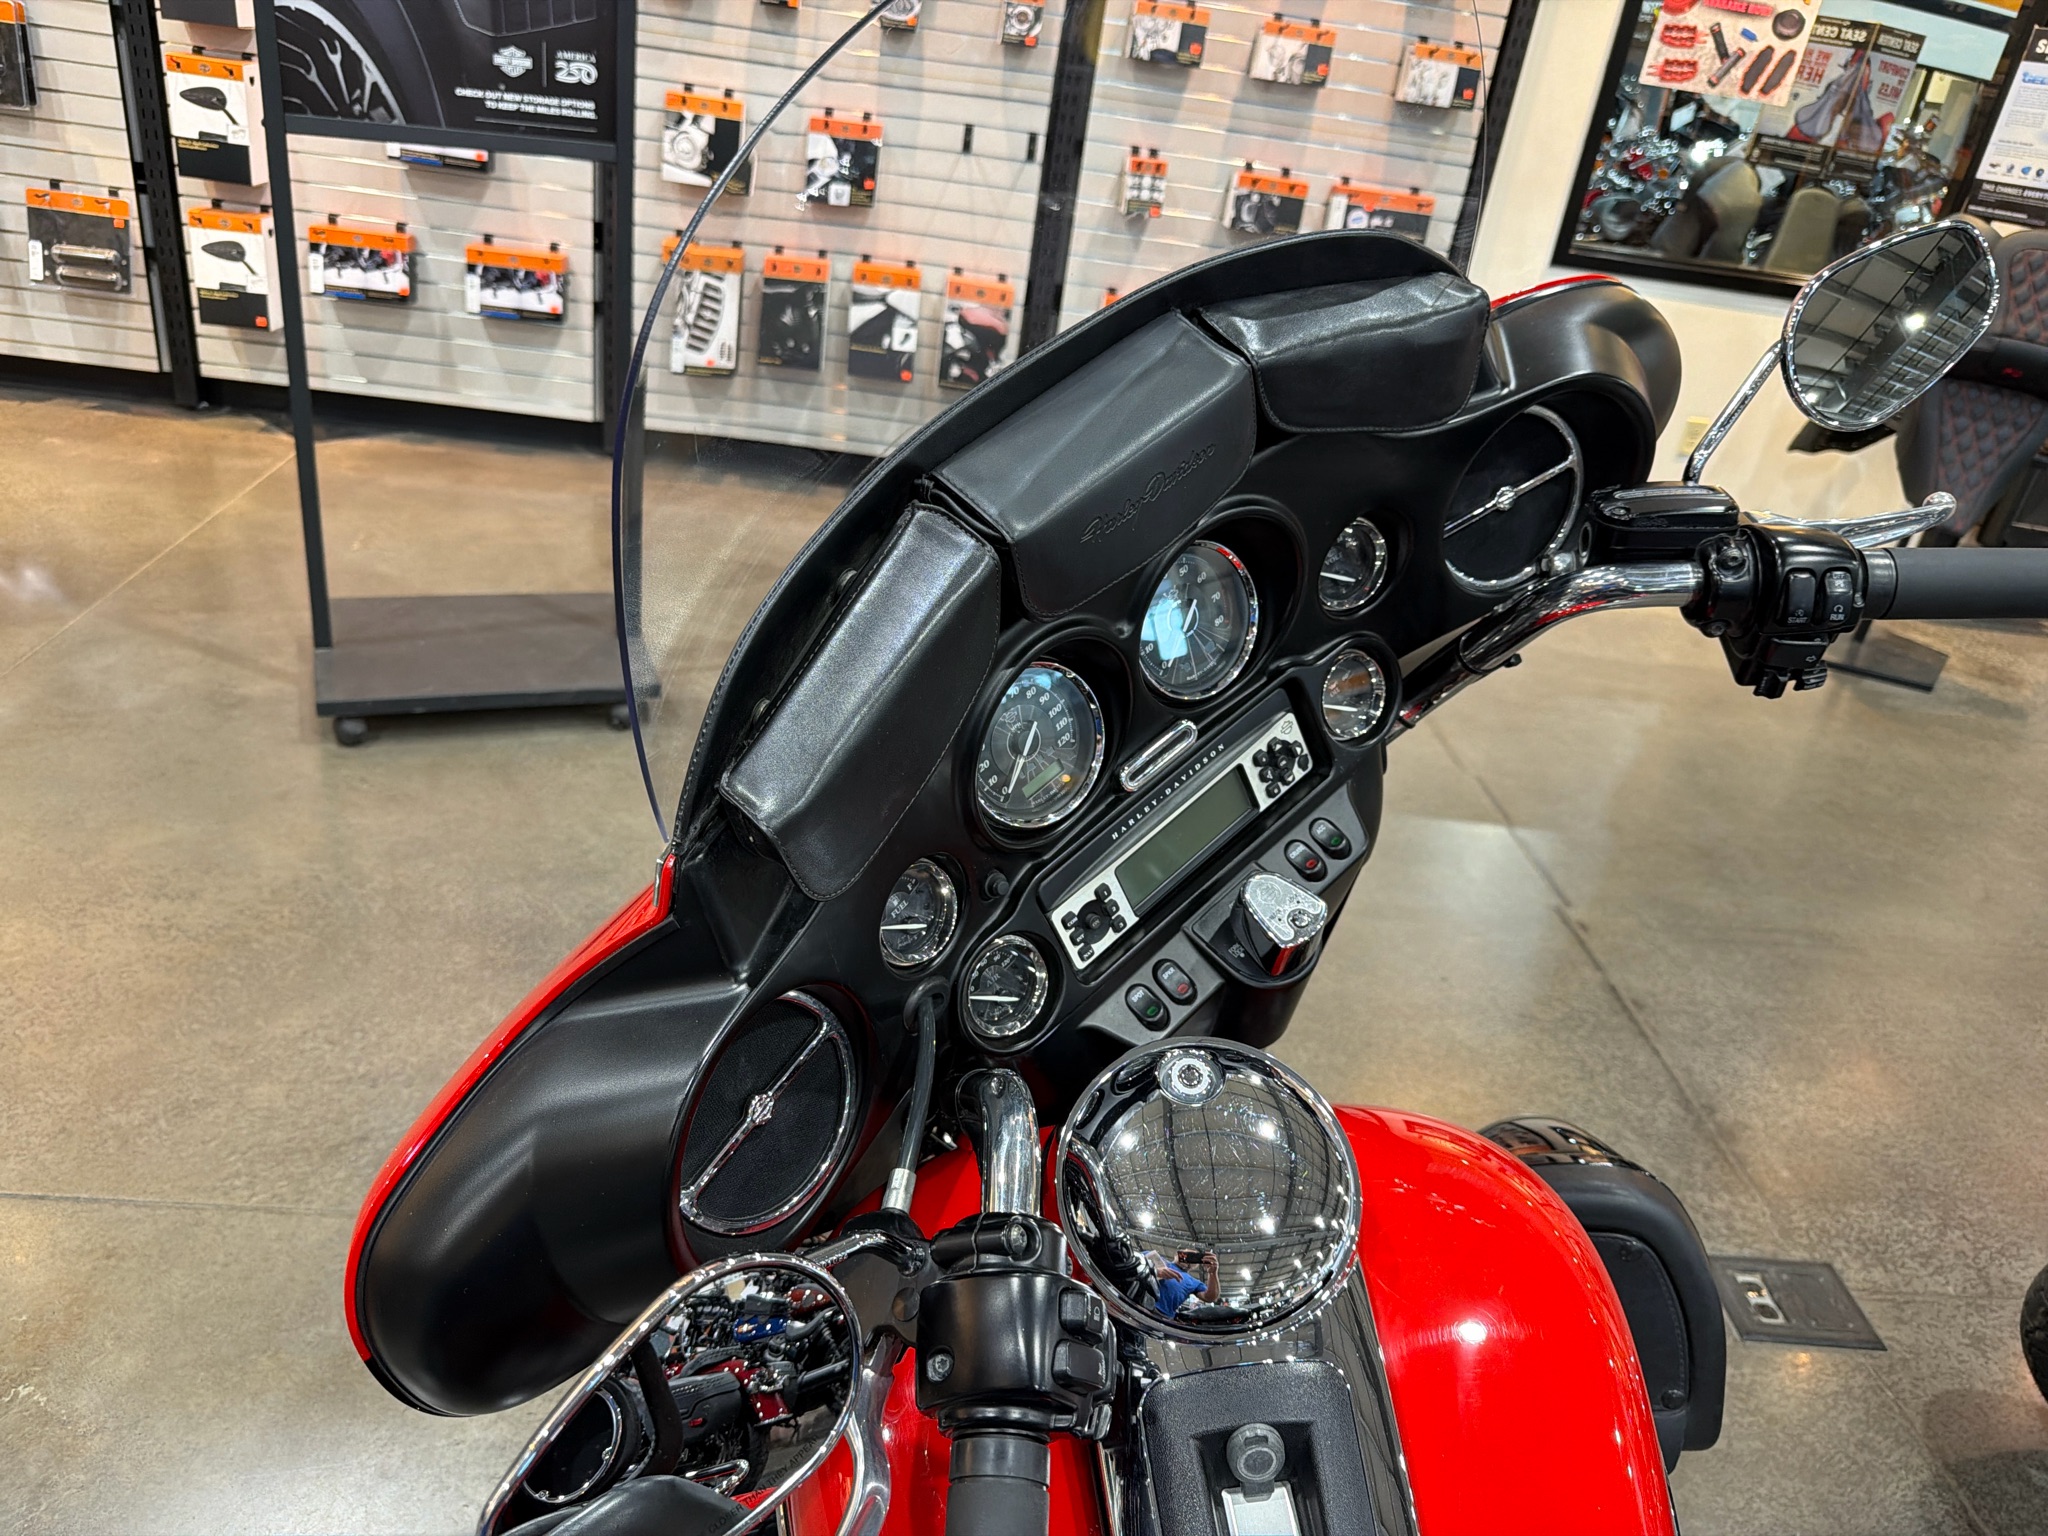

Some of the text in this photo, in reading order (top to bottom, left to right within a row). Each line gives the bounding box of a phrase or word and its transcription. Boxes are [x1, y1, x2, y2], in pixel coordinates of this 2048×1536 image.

[554, 60, 598, 85] 250
[454, 86, 484, 99] CHECK
[484, 89, 502, 100] OUT
[502, 91, 522, 103] NEW
[522, 93, 561, 107] STORAGE
[1178, 564, 1189, 577] 50
[1196, 571, 1207, 584] 60
[1211, 591, 1221, 603] 70
[1214, 615, 1225, 627] 80
[1830, 613, 1846, 621] RUN
[1144, 642, 1154, 655] 10
[1025, 686, 1037, 699] 80
[1039, 692, 1050, 706] 90
[1047, 703, 1063, 719] 100
[1055, 717, 1068, 732] 110
[1057, 732, 1071, 748] 120
[978, 759, 990, 772] 20
[987, 774, 998, 787] 10
[1001, 786, 1008, 795] 0
[1316, 824, 1327, 835] ACC
[890, 900, 909, 919] FUEL
[1162, 966, 1176, 980] SPKR
[986, 973, 1001, 988] AIR
[1131, 989, 1145, 1003] SPOT
[708, 1434, 821, 1534] CLOSER THAN THEY APPEAR
